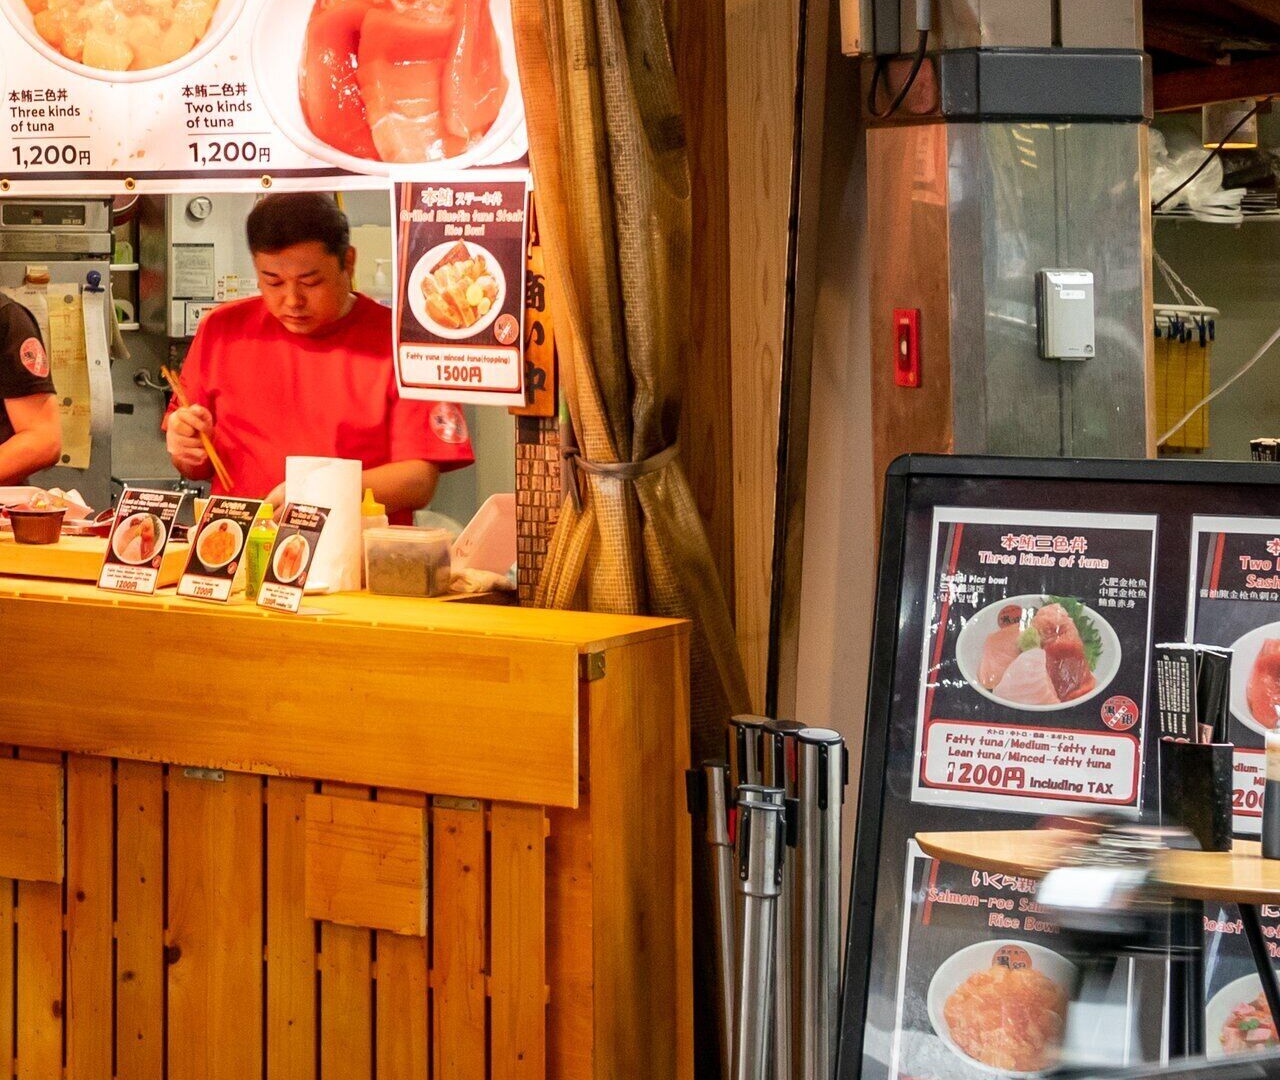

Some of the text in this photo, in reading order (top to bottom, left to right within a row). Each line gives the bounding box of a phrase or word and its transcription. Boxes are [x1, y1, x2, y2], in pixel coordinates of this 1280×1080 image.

[8, 89, 68, 103] 本鮪三色丼
[181, 82, 248, 98] 本鮪二色丼
[10, 105, 81, 118] Three kinds
[184, 100, 253, 113] Two kinds
[11, 121, 55, 132] of tuna
[186, 116, 234, 128] of tuna
[12, 144, 91, 169] 1,200円
[188, 141, 271, 165] 1,200円
[400, 209, 434, 222] Grilled
[444, 224, 485, 236] Rice Bowl
[436, 366, 482, 383] 1500円
[1001, 533, 1088, 554] 本鮪三色丼
[978, 551, 1016, 565] Three
[1059, 554, 1076, 567] of
[1078, 554, 1110, 569] tuna
[1239, 556, 1273, 571] Two
[946, 734, 976, 746] Fatty
[1091, 744, 1116, 756] tuna
[948, 746, 974, 757] Lean
[1086, 758, 1111, 769] tuna
[947, 762, 1114, 795] 1200円 TAX
[928, 887, 1014, 910] Salmon-roe
[988, 913, 1020, 929] Rice
